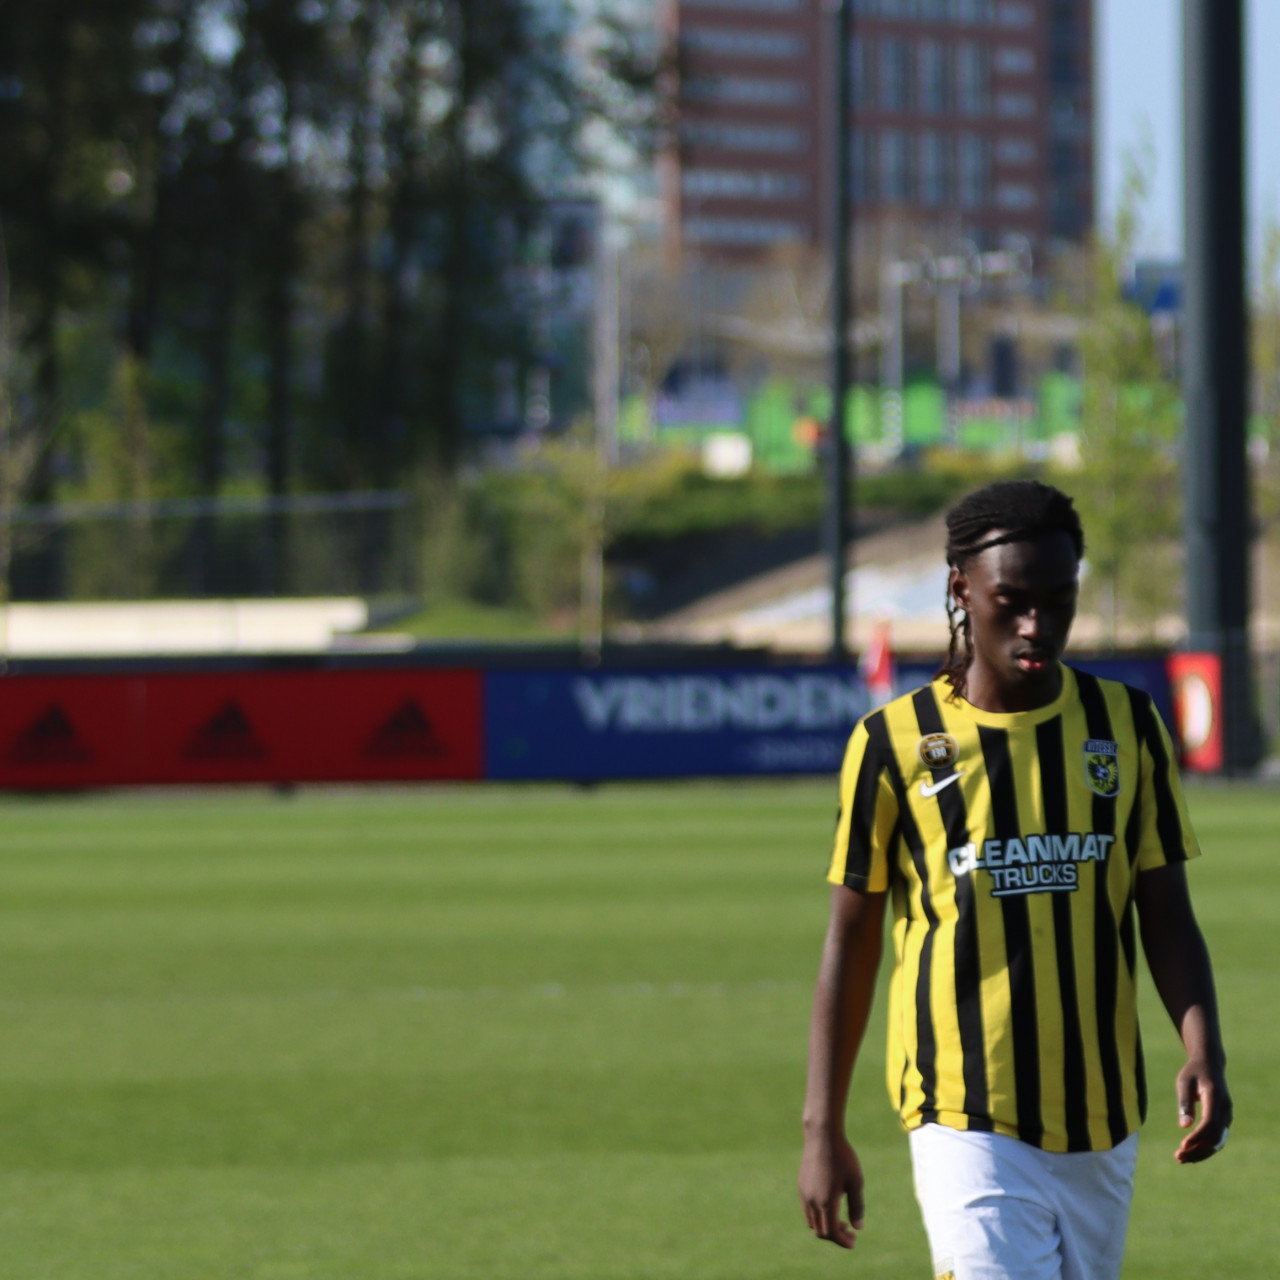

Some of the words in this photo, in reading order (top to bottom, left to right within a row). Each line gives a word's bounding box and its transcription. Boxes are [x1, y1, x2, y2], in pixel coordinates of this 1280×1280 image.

[574, 676, 870, 730] VRIENDEN
[949, 834, 1116, 876] CLEANMAT
[989, 863, 1077, 889] TRUCKS
